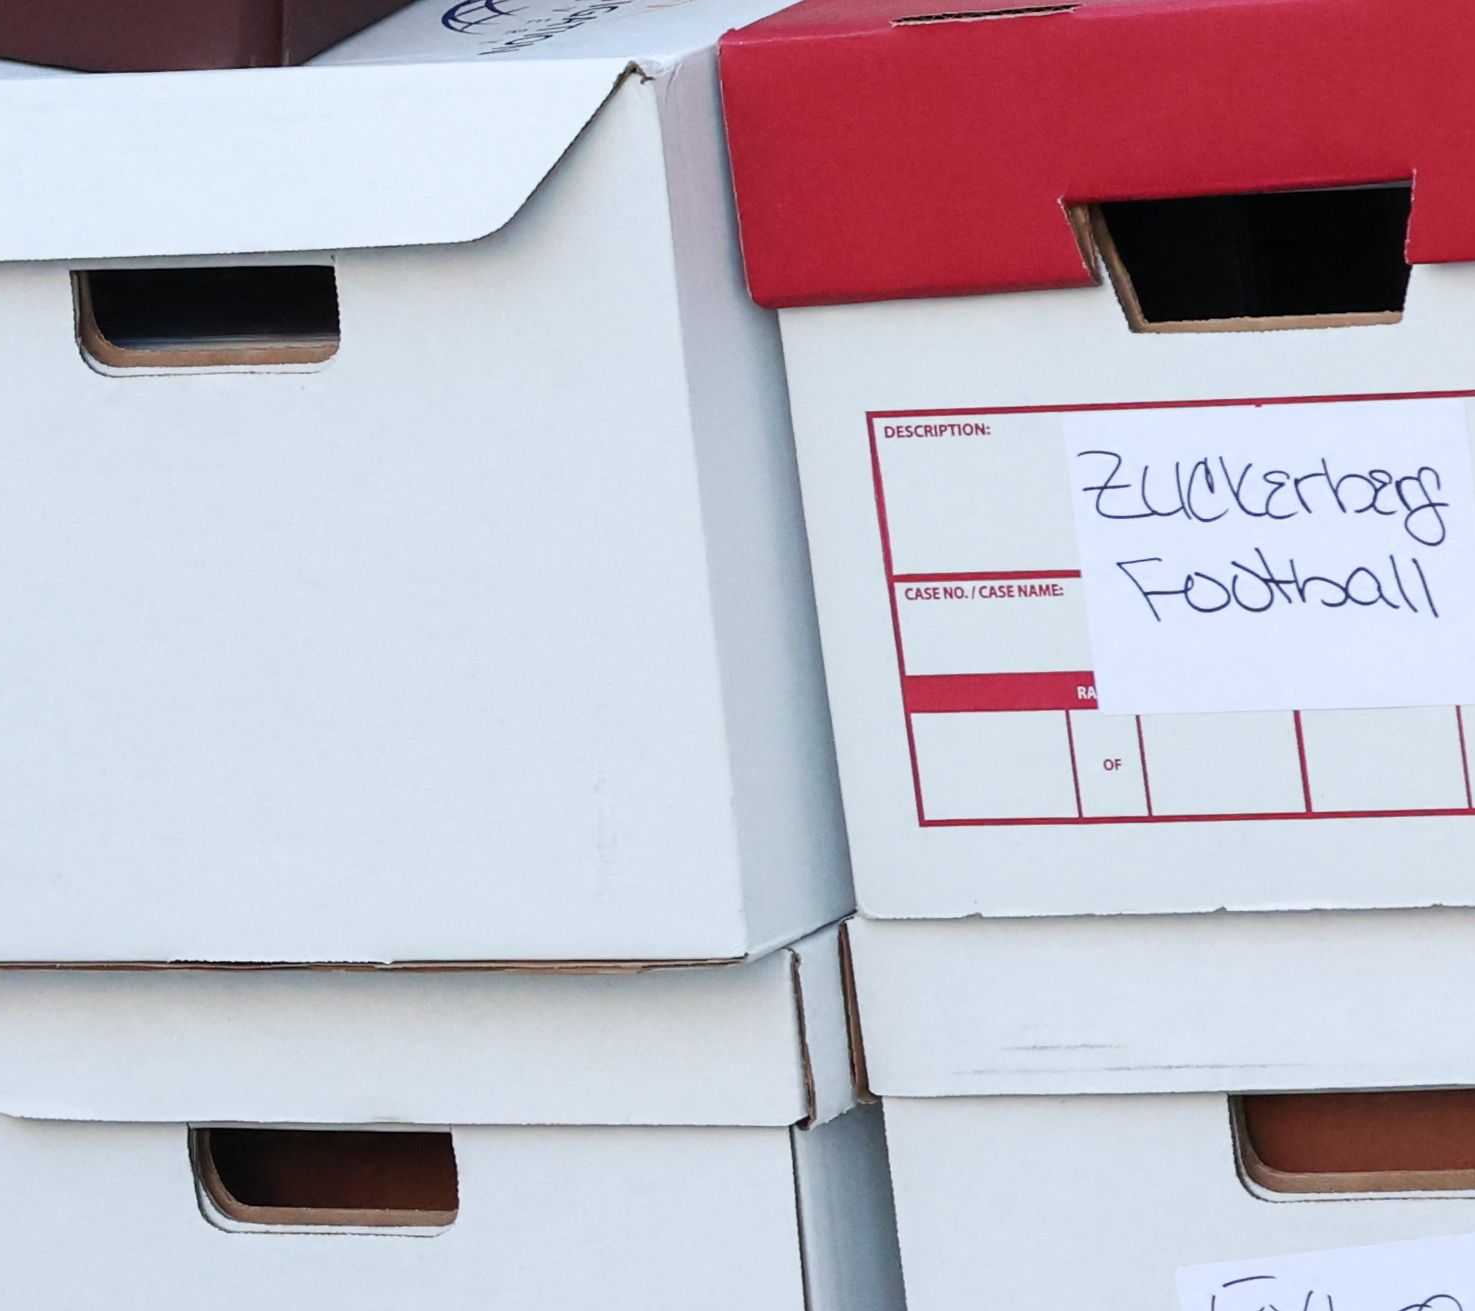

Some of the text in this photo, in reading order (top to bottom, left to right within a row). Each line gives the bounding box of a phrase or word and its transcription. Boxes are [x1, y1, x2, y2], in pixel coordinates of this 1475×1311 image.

[884, 423, 991, 439] DESCRIPTION:
[1077, 451, 1449, 546] Zuckerberg
[904, 587, 941, 601] CASE
[943, 586, 969, 600] NO.
[978, 585, 1015, 599] CASE
[1018, 583, 1064, 598] NAME:
[1116, 547, 1441, 622] Football
[1103, 758, 1122, 772] OF
